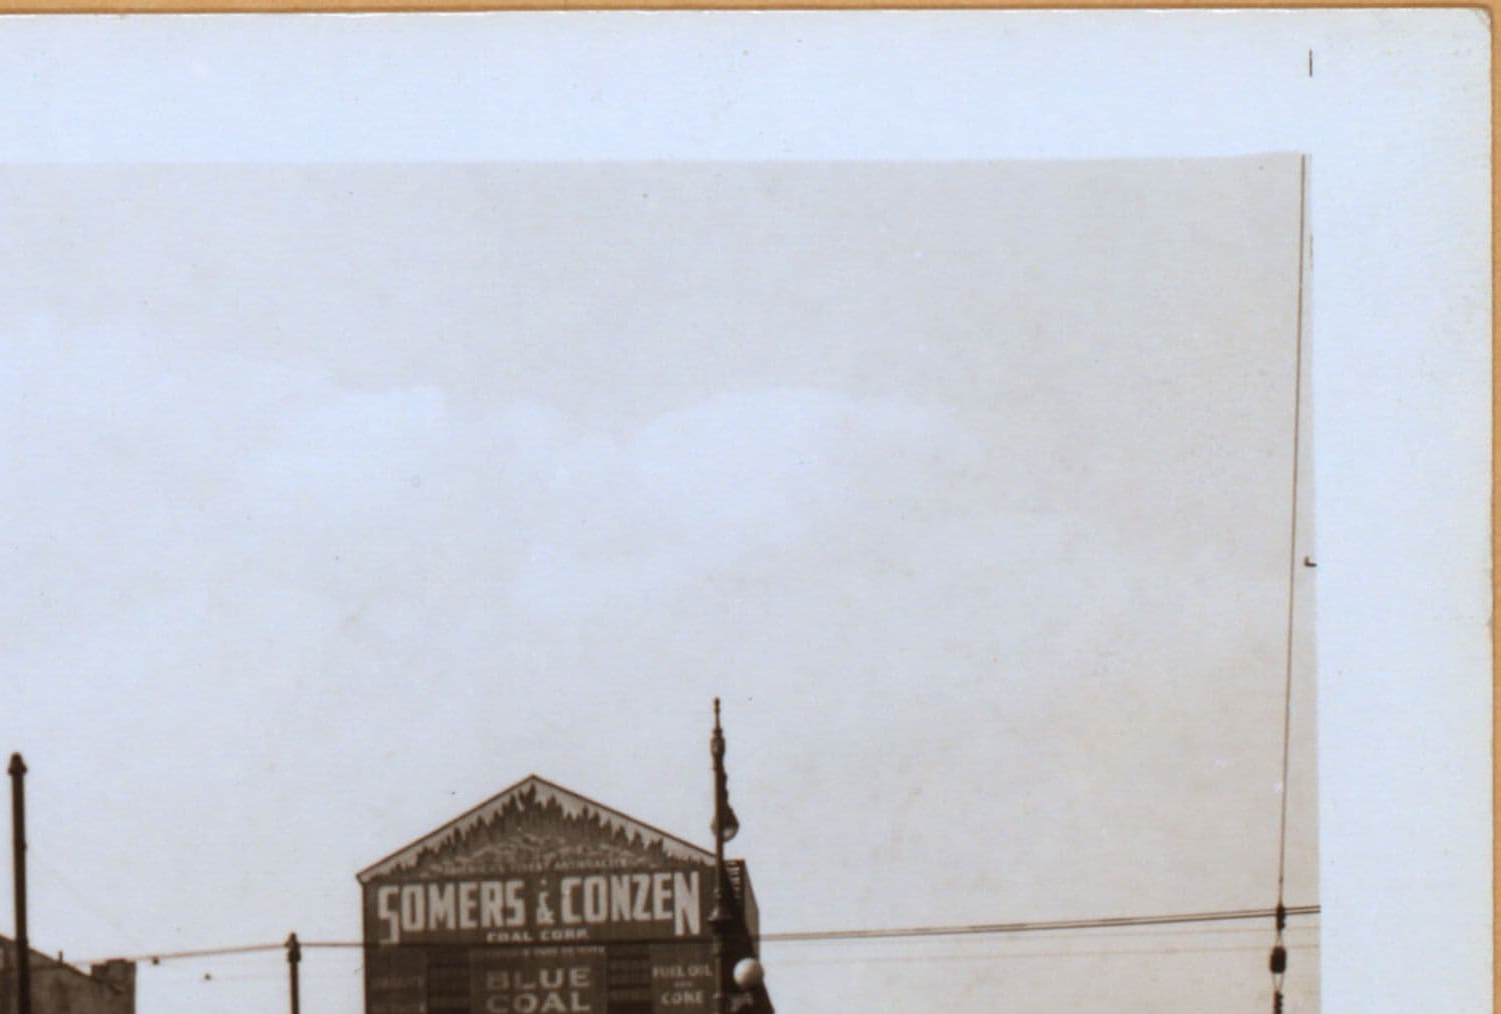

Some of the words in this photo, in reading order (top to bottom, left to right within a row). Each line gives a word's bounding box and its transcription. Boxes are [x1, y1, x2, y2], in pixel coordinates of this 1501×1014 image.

[377, 879, 526, 944] SOMERS
[536, 880, 554, 925] &
[560, 871, 700, 936] CONZEN
[486, 930, 533, 942] COAL
[486, 968, 591, 991] BLUE
[652, 965, 684, 978] FUEL
[688, 964, 713, 977] OIL
[486, 991, 591, 1014] COAL
[661, 991, 705, 1006] COKE
